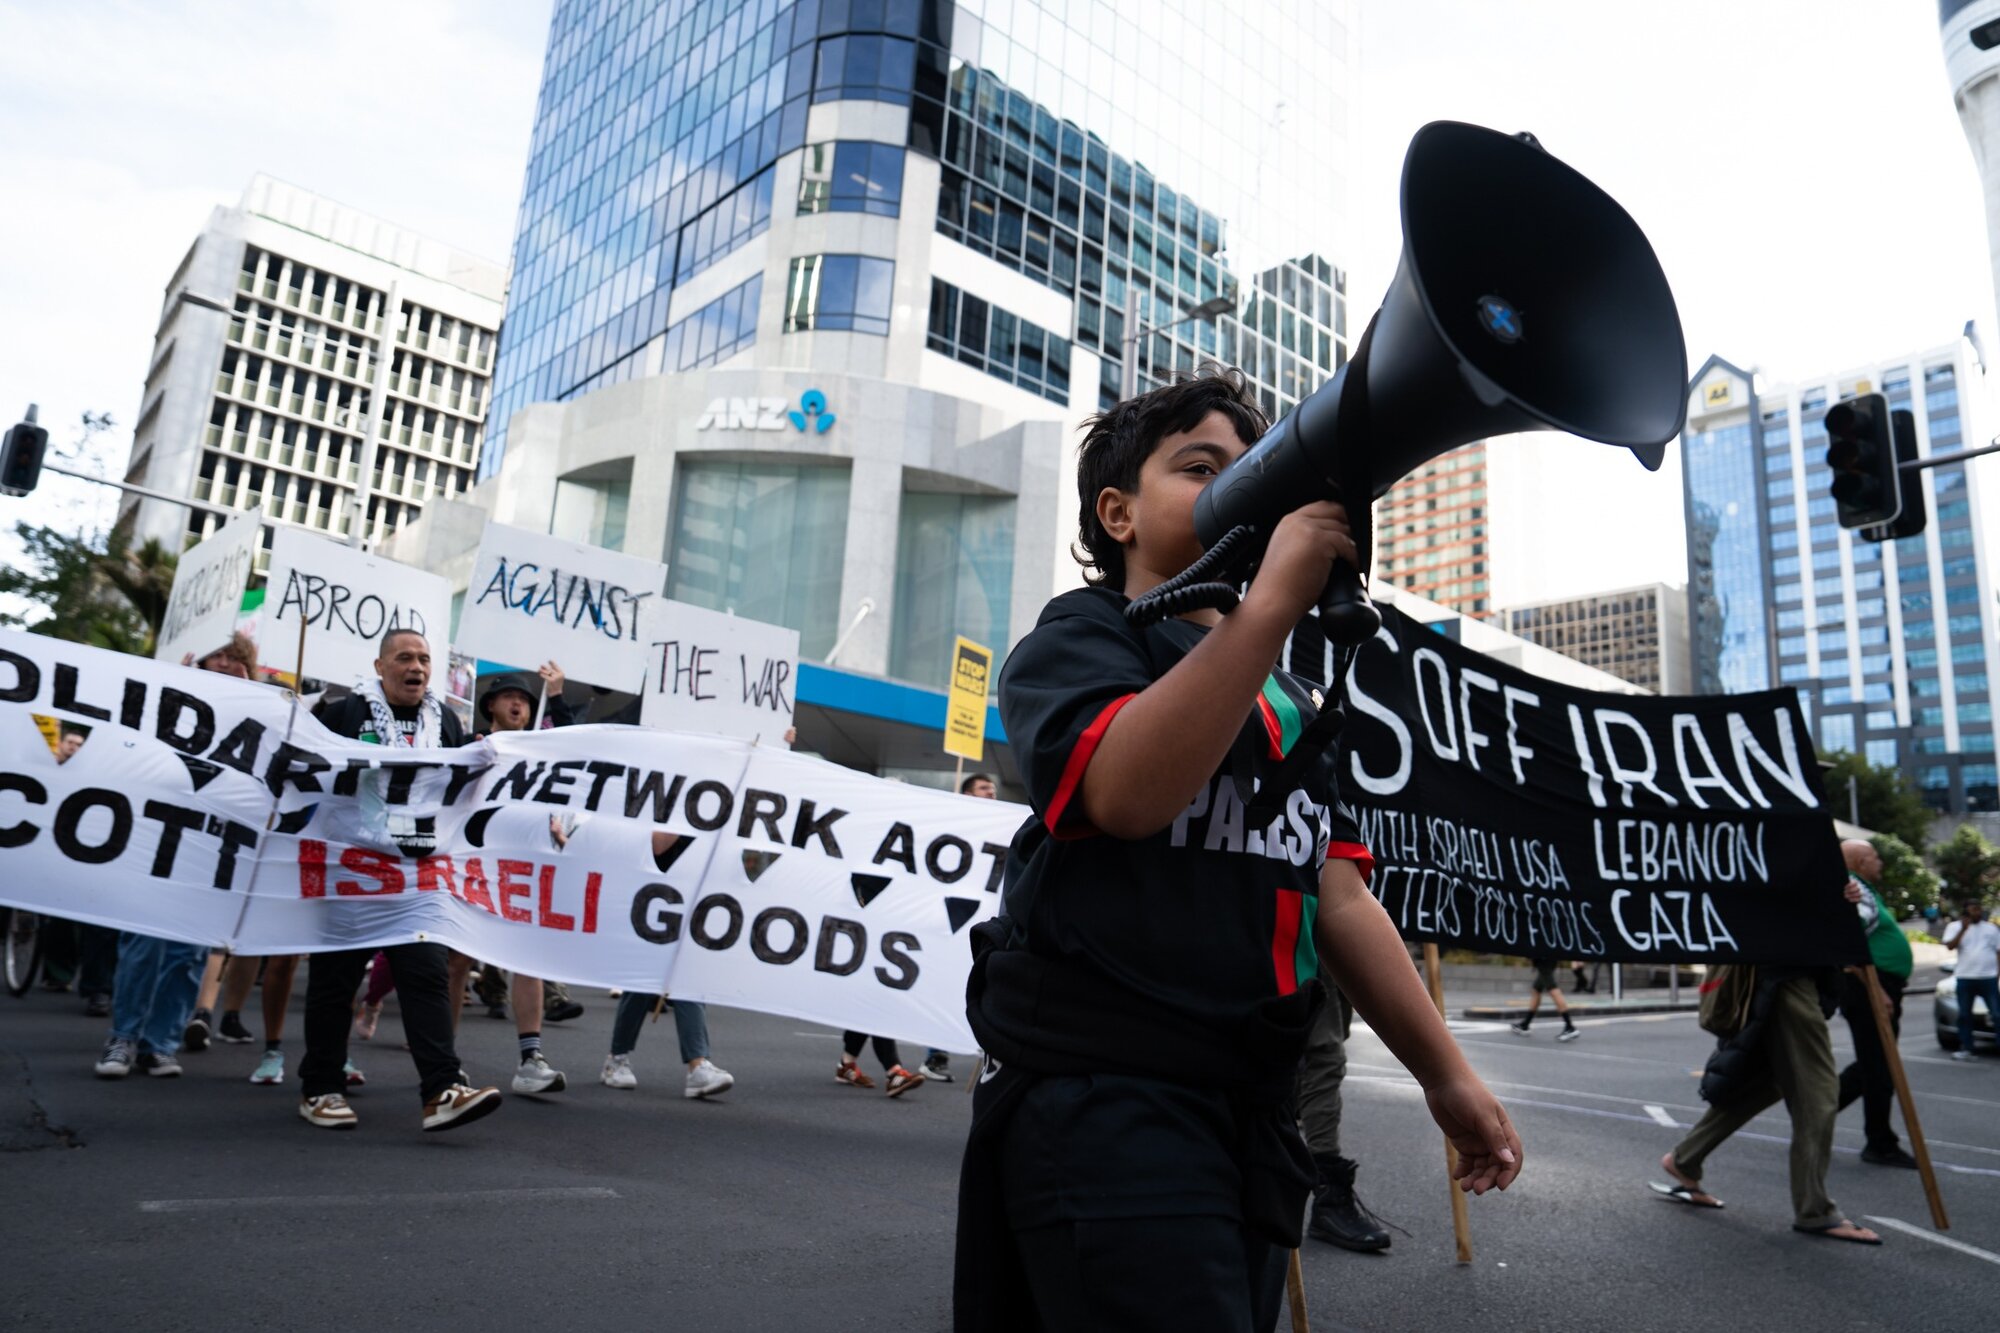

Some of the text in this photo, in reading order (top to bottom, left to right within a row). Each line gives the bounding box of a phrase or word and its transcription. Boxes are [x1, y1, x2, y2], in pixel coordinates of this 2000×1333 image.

[697, 397, 789, 430] ANZ
[276, 567, 426, 640] ABROAD
[476, 556, 653, 641] AGAINST
[652, 640, 792, 714] THE WAR
[1413, 648, 1540, 786] OFF
[1568, 703, 1819, 809] IRAN
[486, 759, 850, 858] NETWORK
[0, 772, 923, 991] COTT ISRAELI GOODS
[1351, 804, 1571, 892] WITH ISRAELI USA
[1594, 818, 1769, 884] LEBANON
[1468, 882, 1519, 945] YOU
[1523, 893, 1606, 956] FOOLS
[1610, 887, 1739, 953] GAZA
